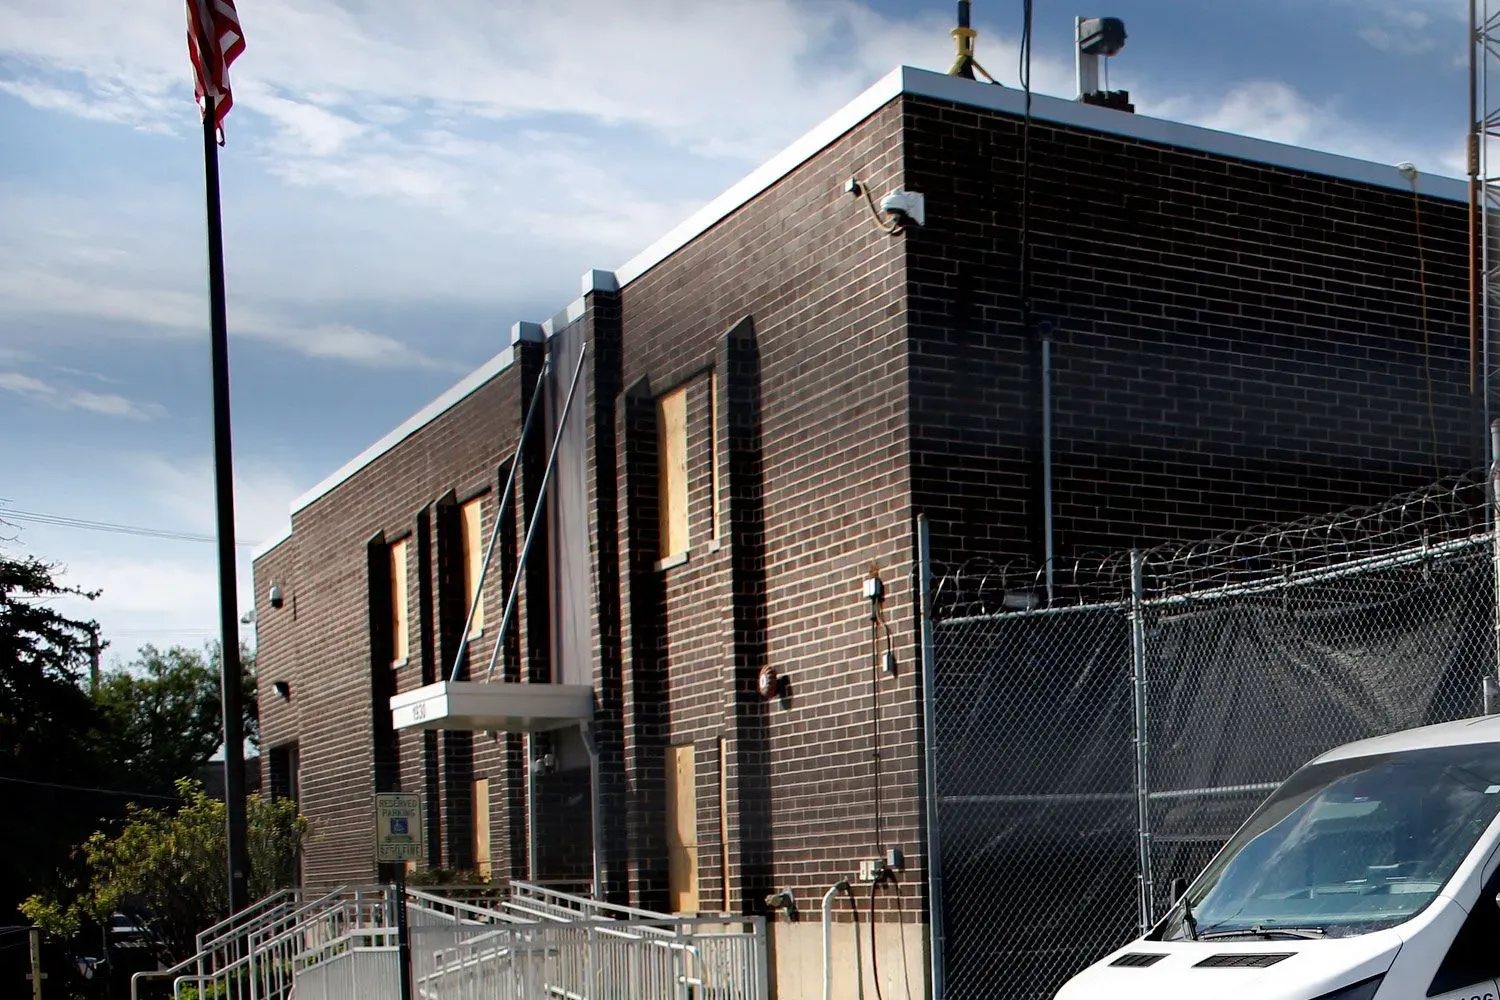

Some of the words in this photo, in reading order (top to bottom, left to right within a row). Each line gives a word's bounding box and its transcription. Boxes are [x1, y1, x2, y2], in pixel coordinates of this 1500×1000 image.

[379, 799, 418, 808] RESERVED
[382, 809, 416, 817] PARKING
[402, 845, 421, 856] FINE
